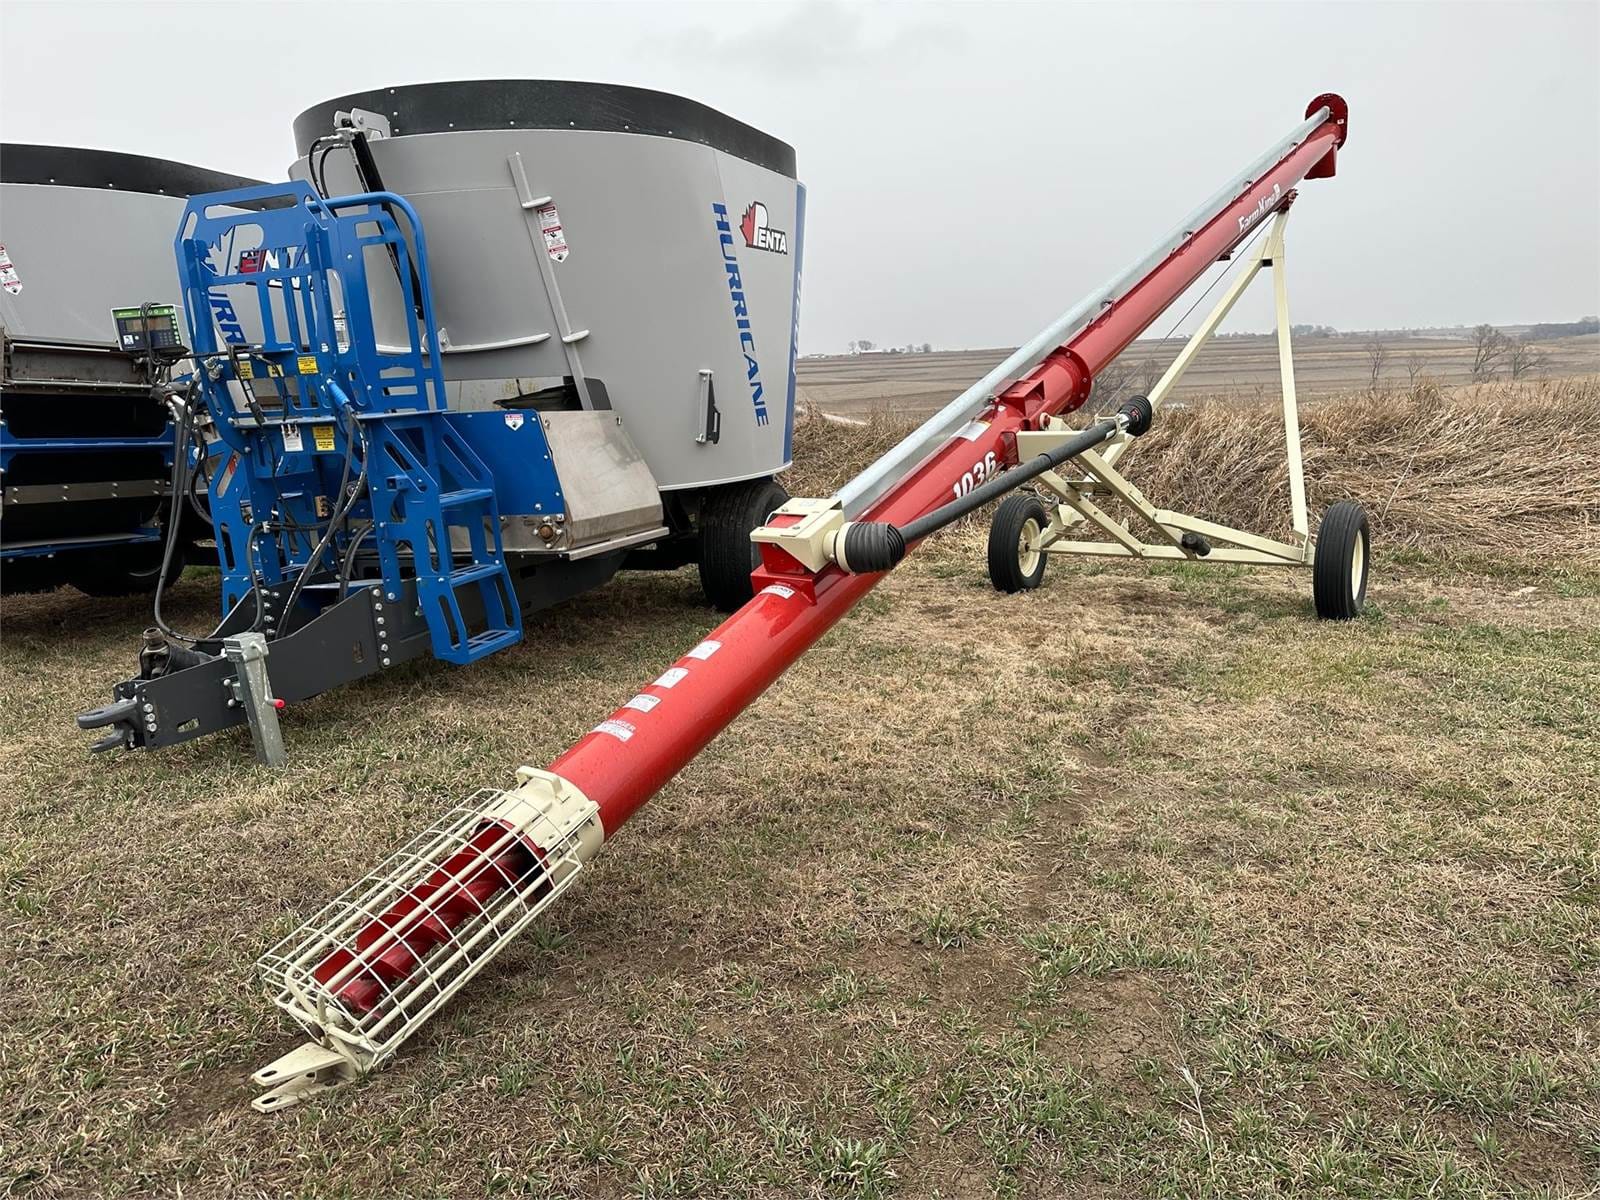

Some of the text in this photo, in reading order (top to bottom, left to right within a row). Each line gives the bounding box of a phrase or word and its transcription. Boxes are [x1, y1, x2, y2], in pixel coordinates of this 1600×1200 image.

[752, 201, 788, 255] PENTA
[712, 202, 769, 428] HURRICANE
[953, 450, 997, 498] 1036
